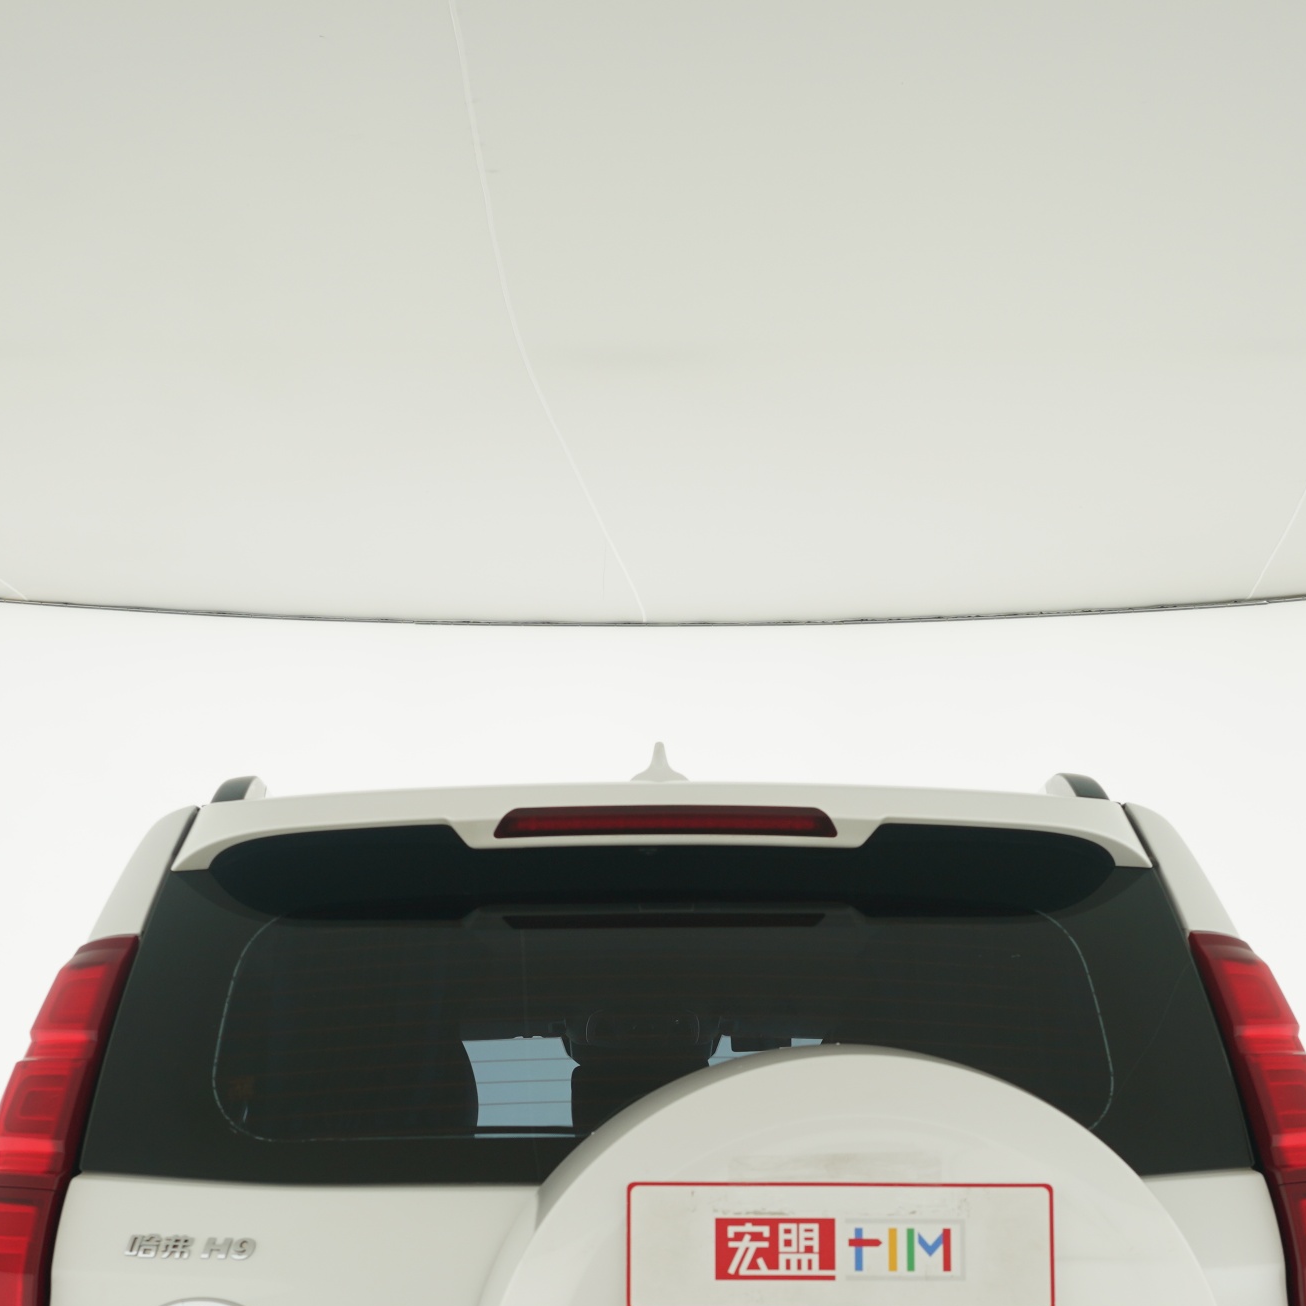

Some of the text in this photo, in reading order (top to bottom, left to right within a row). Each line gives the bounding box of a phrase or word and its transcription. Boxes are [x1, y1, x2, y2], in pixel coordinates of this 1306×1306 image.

[125, 1233, 257, 1260] 哈弗 H9
[727, 1222, 836, 1276] 宏盟
